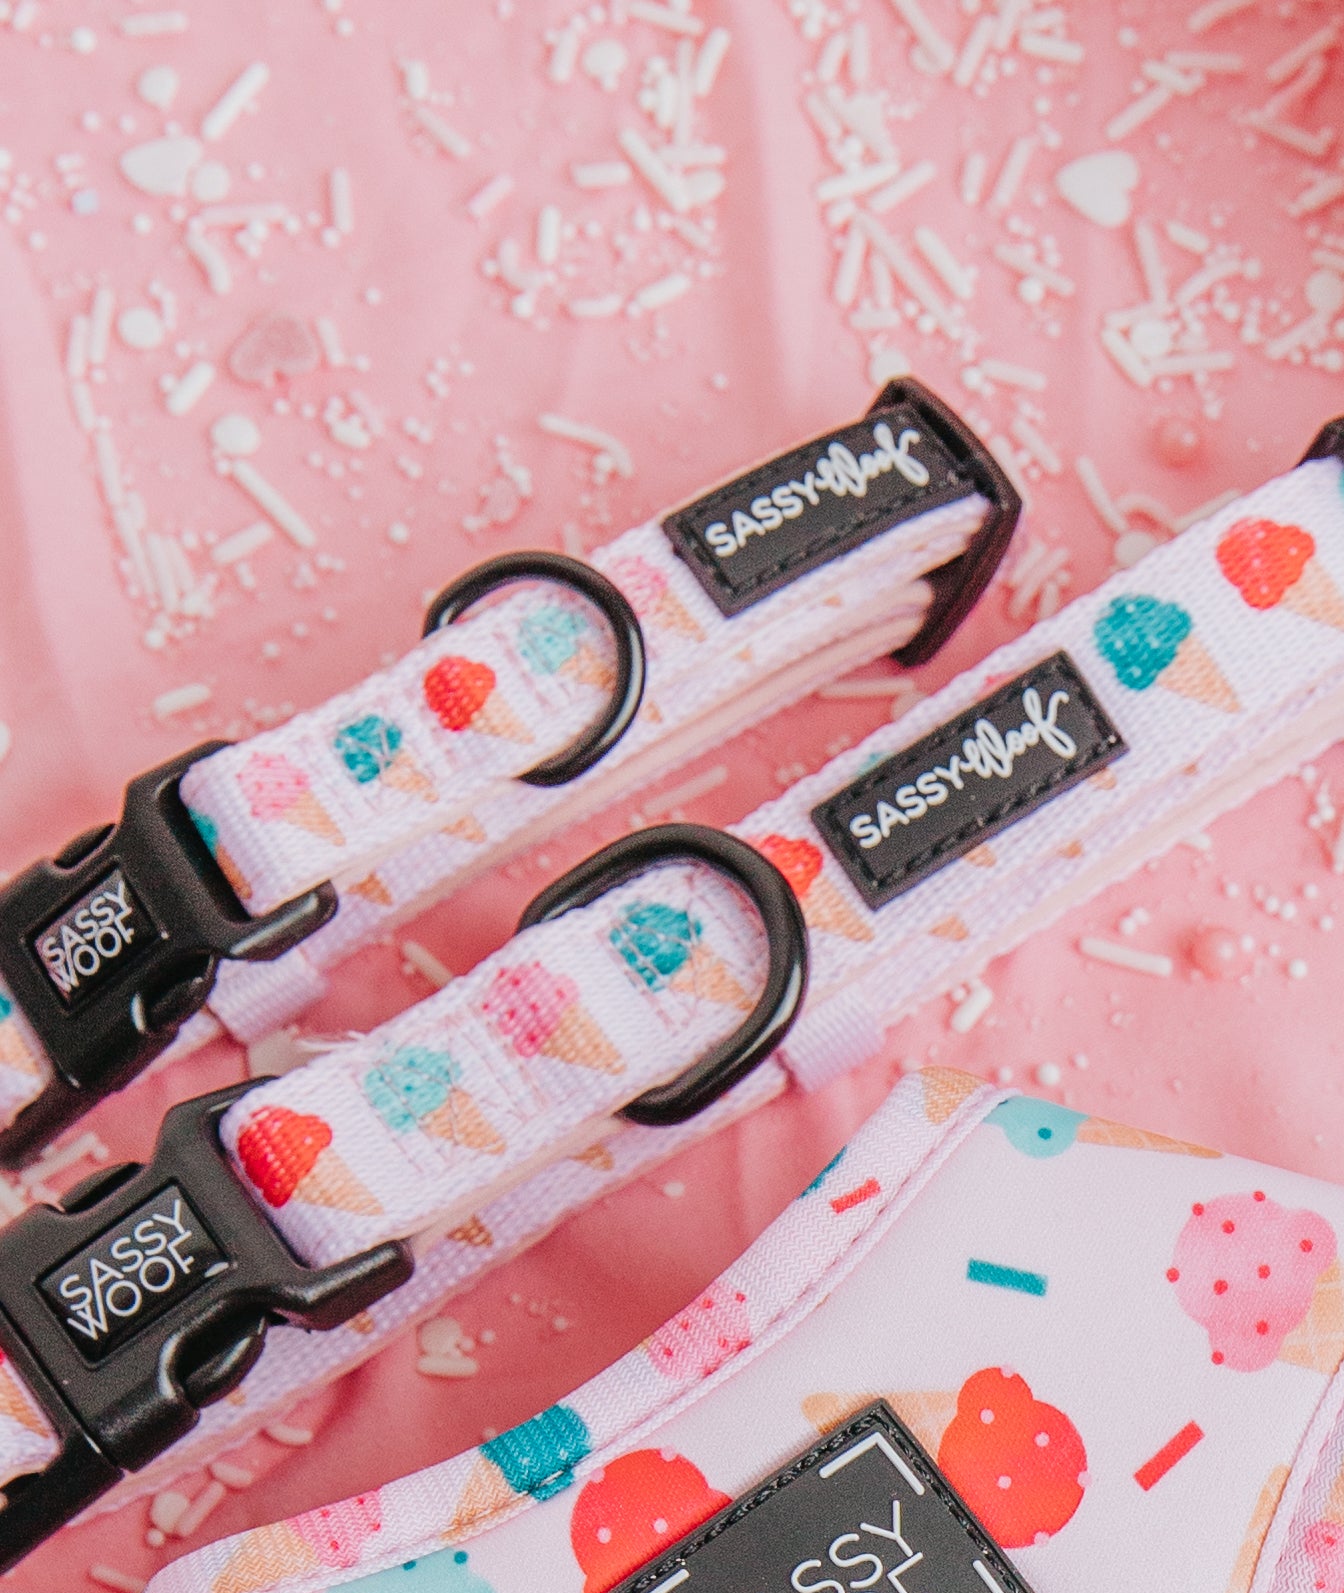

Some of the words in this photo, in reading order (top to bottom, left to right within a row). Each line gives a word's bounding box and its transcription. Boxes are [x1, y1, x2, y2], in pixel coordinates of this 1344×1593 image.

[703, 477, 819, 558] SASSY
[849, 757, 964, 850] SASSY
[42, 879, 131, 964] SASSY
[48, 906, 136, 993] WOOF
[59, 1199, 186, 1311] SASSY
[66, 1230, 195, 1341] WOOF
